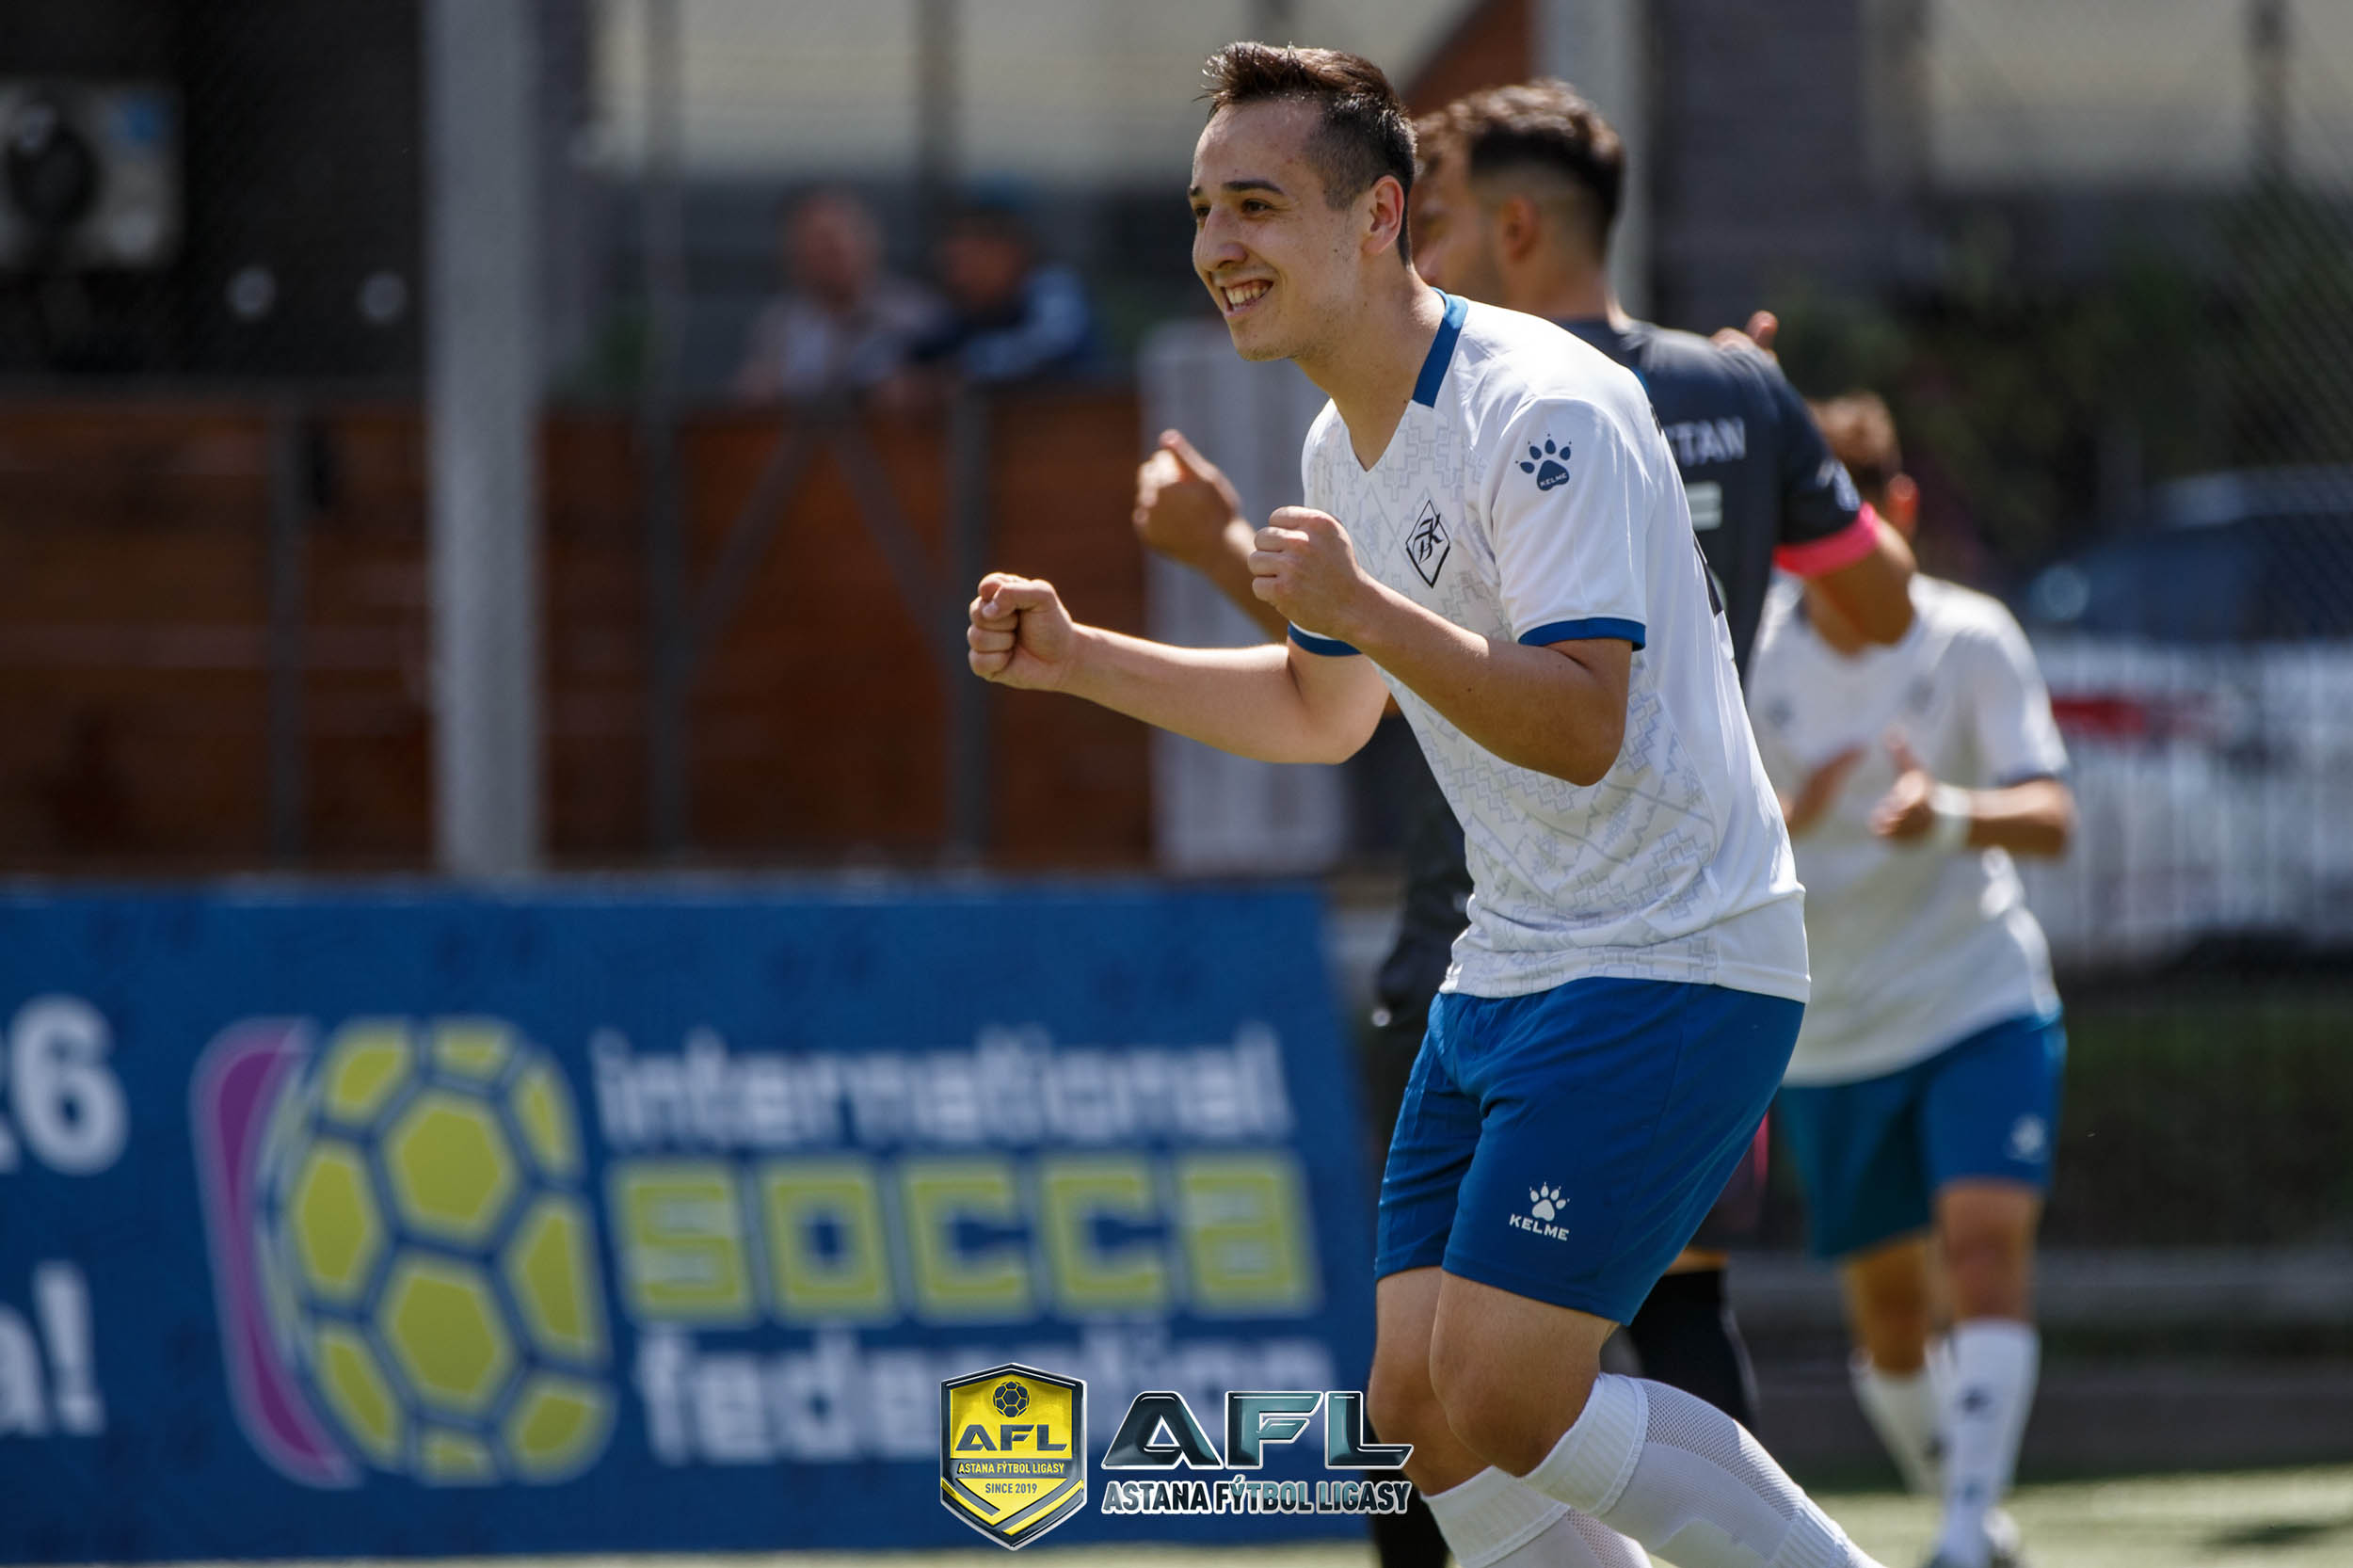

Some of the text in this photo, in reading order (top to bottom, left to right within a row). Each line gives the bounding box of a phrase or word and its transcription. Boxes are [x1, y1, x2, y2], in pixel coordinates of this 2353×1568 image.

[1666, 417, 1746, 466] TAN
[1539, 472, 1567, 487] KELME
[0, 995, 130, 1175] 6
[595, 1031, 1293, 1143] international
[1509, 1213, 1570, 1241] KELME
